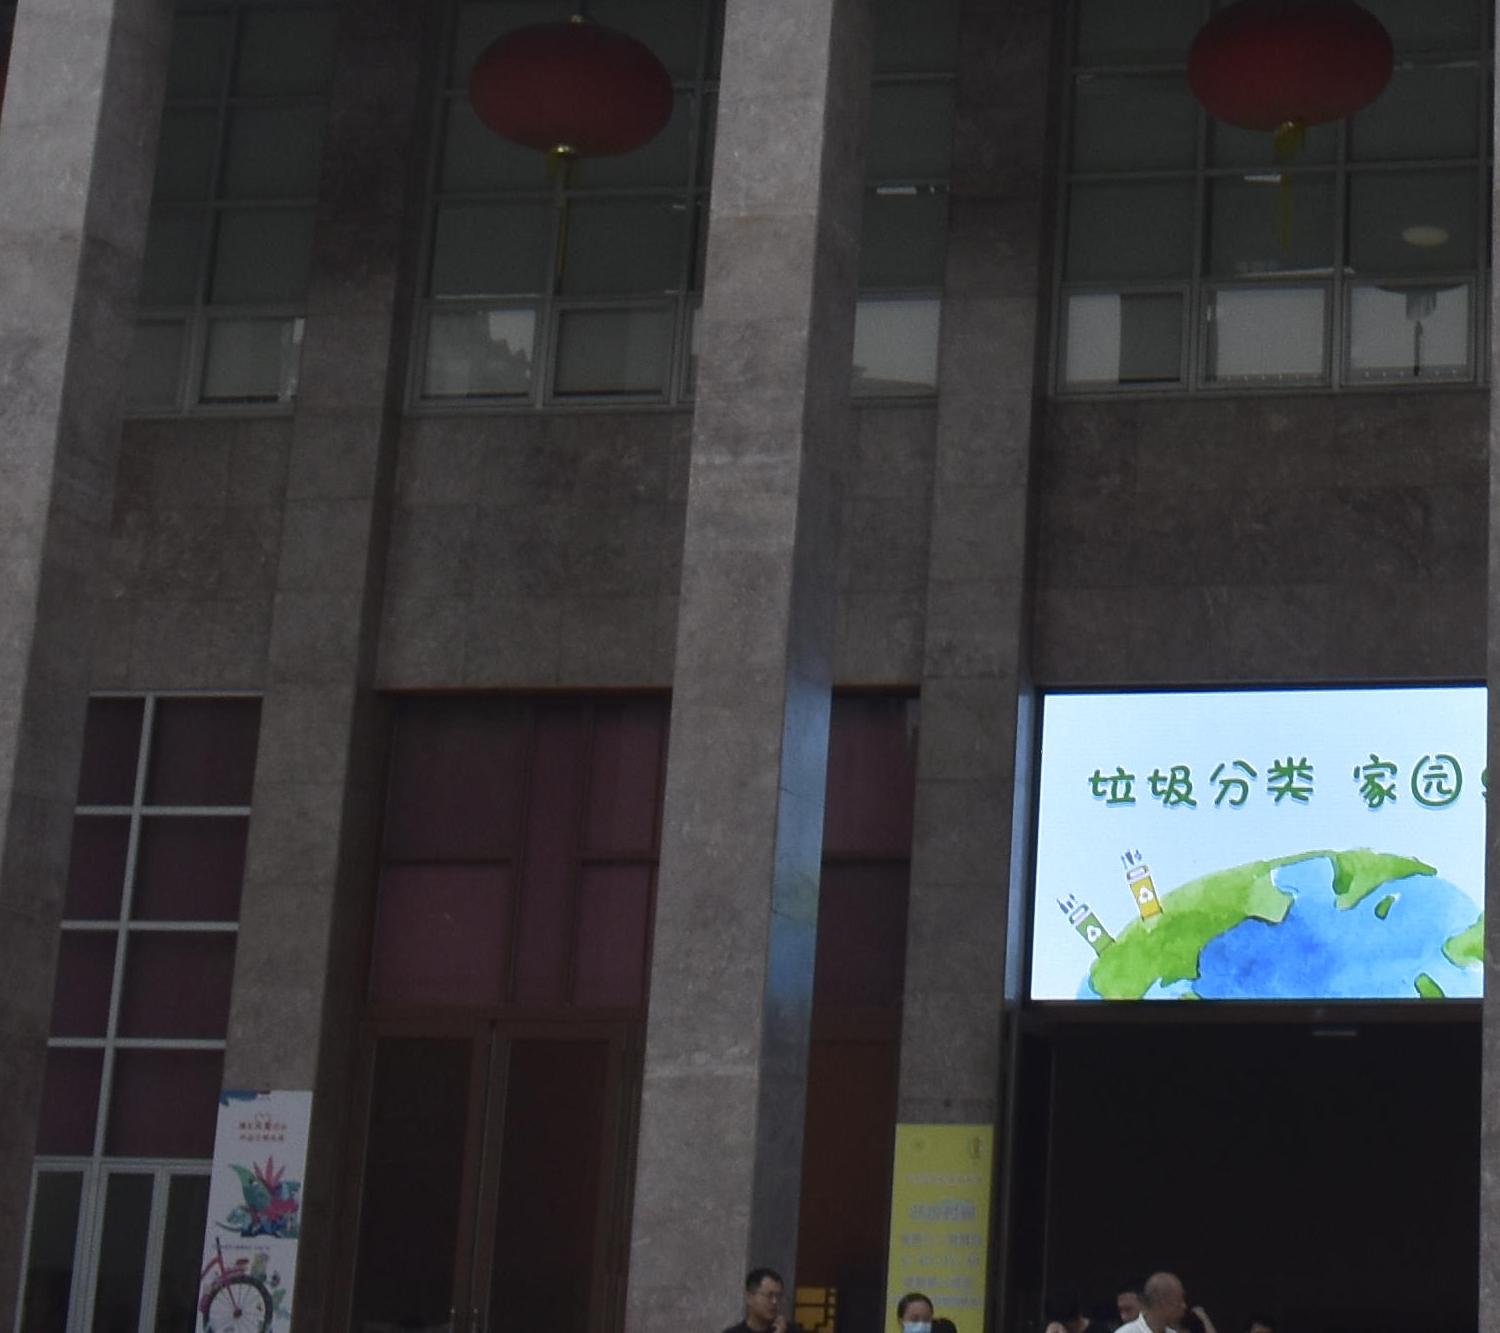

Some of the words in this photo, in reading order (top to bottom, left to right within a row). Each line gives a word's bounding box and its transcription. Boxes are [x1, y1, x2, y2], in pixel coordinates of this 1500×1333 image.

[1087, 755, 1316, 809] 垃圾分类
[1352, 751, 1488, 810] 家园
